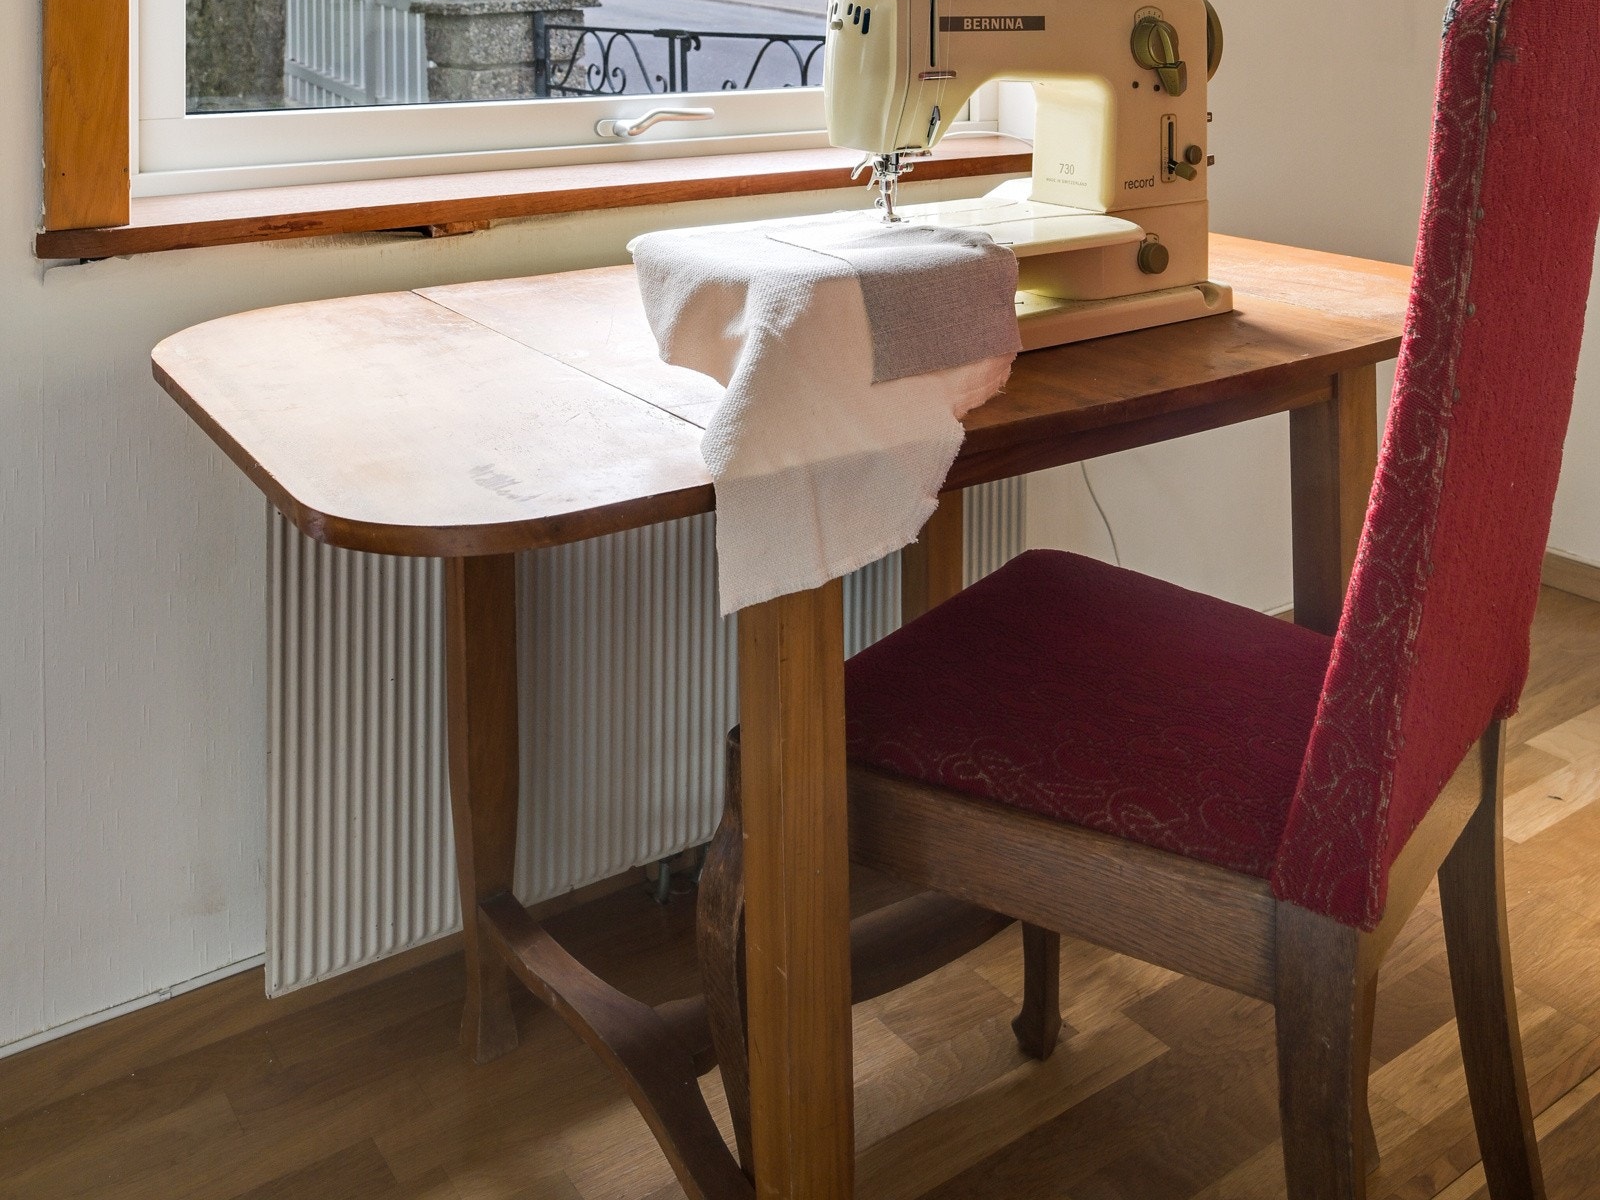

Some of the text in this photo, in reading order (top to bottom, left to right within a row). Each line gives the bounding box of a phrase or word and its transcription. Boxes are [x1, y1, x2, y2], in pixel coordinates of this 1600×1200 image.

[963, 18, 1024, 30] BERNINA
[1059, 163, 1075, 175] 730
[1123, 175, 1155, 190] record
